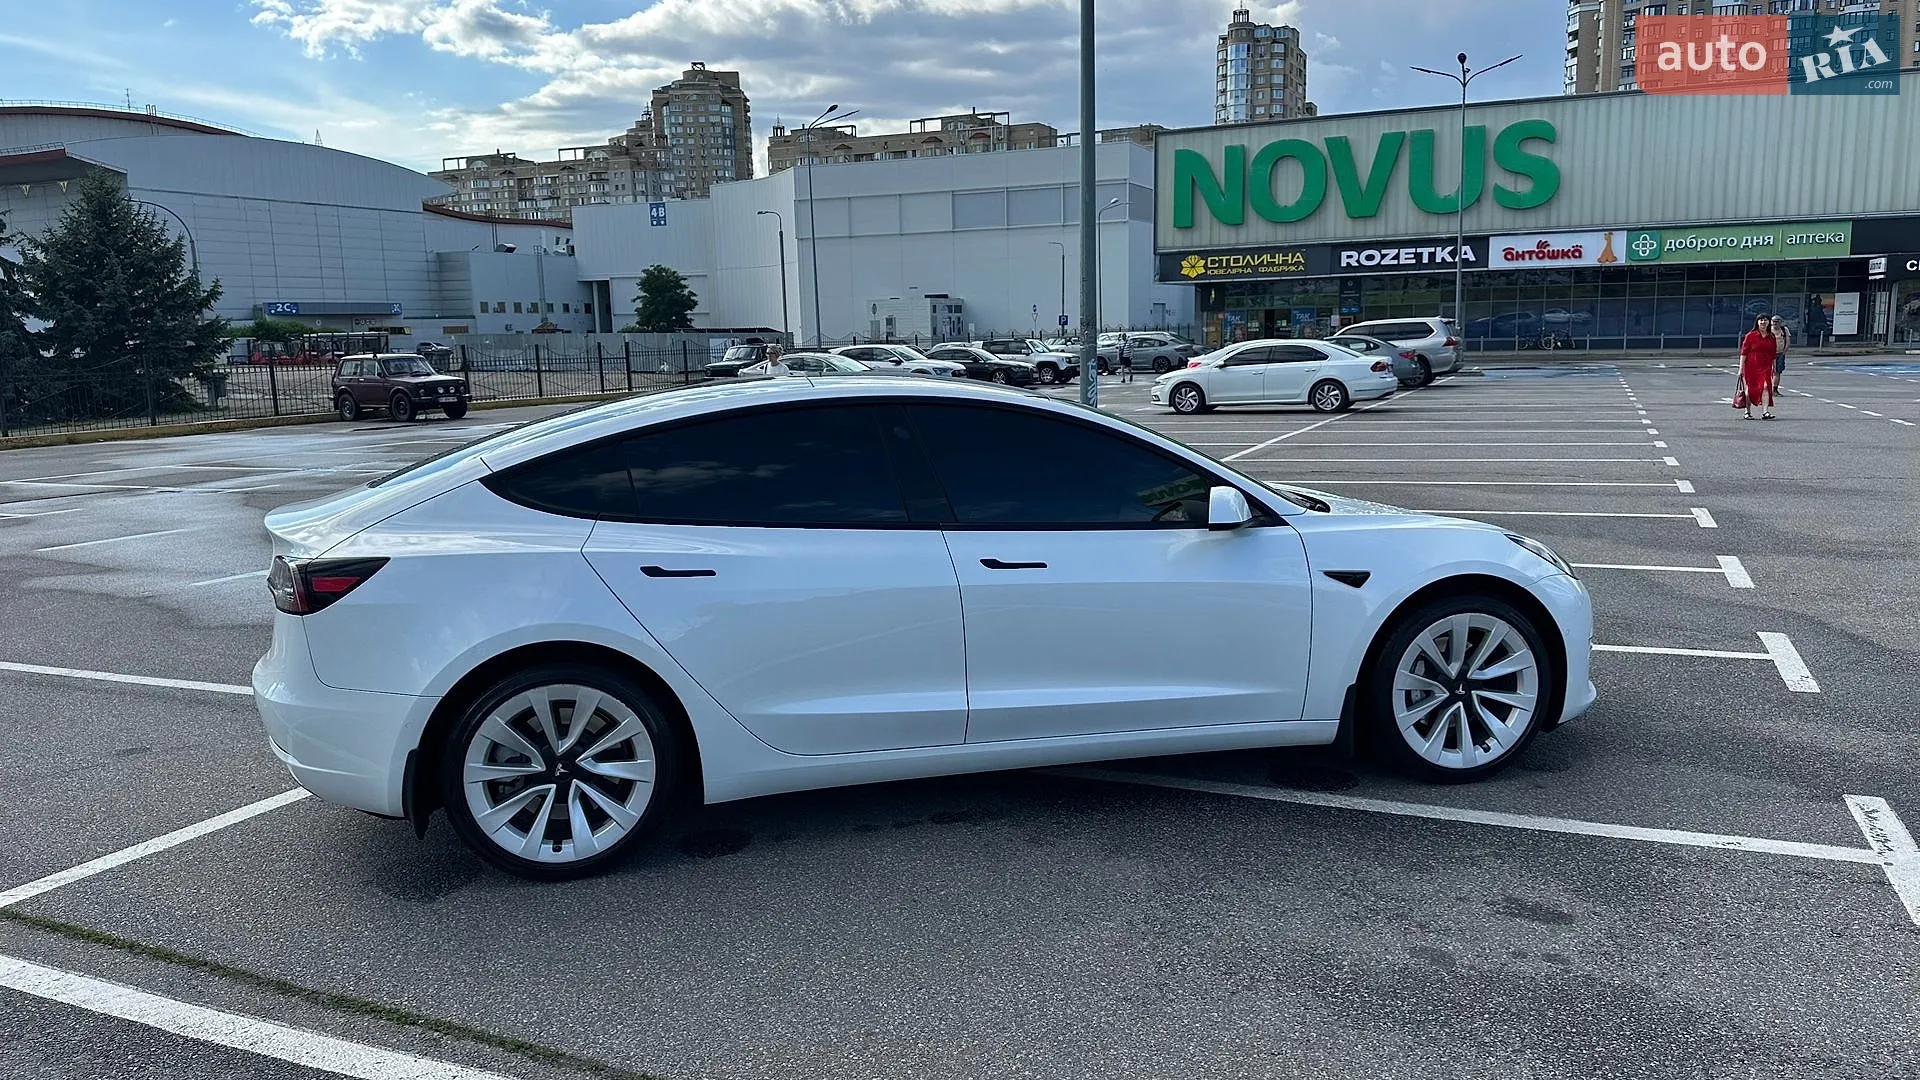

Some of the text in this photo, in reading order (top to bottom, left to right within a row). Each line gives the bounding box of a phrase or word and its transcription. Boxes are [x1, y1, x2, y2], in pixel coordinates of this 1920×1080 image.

[1173, 119, 1560, 229] NOVUS
[1664, 232, 1845, 252] доброго дня аптека
[1207, 252, 1305, 268] СТОЛИЧНА
[1340, 245, 1476, 267] ROZETKA
[1207, 265, 1305, 275] ЮВЕЛІРНА ФАБРИКА
